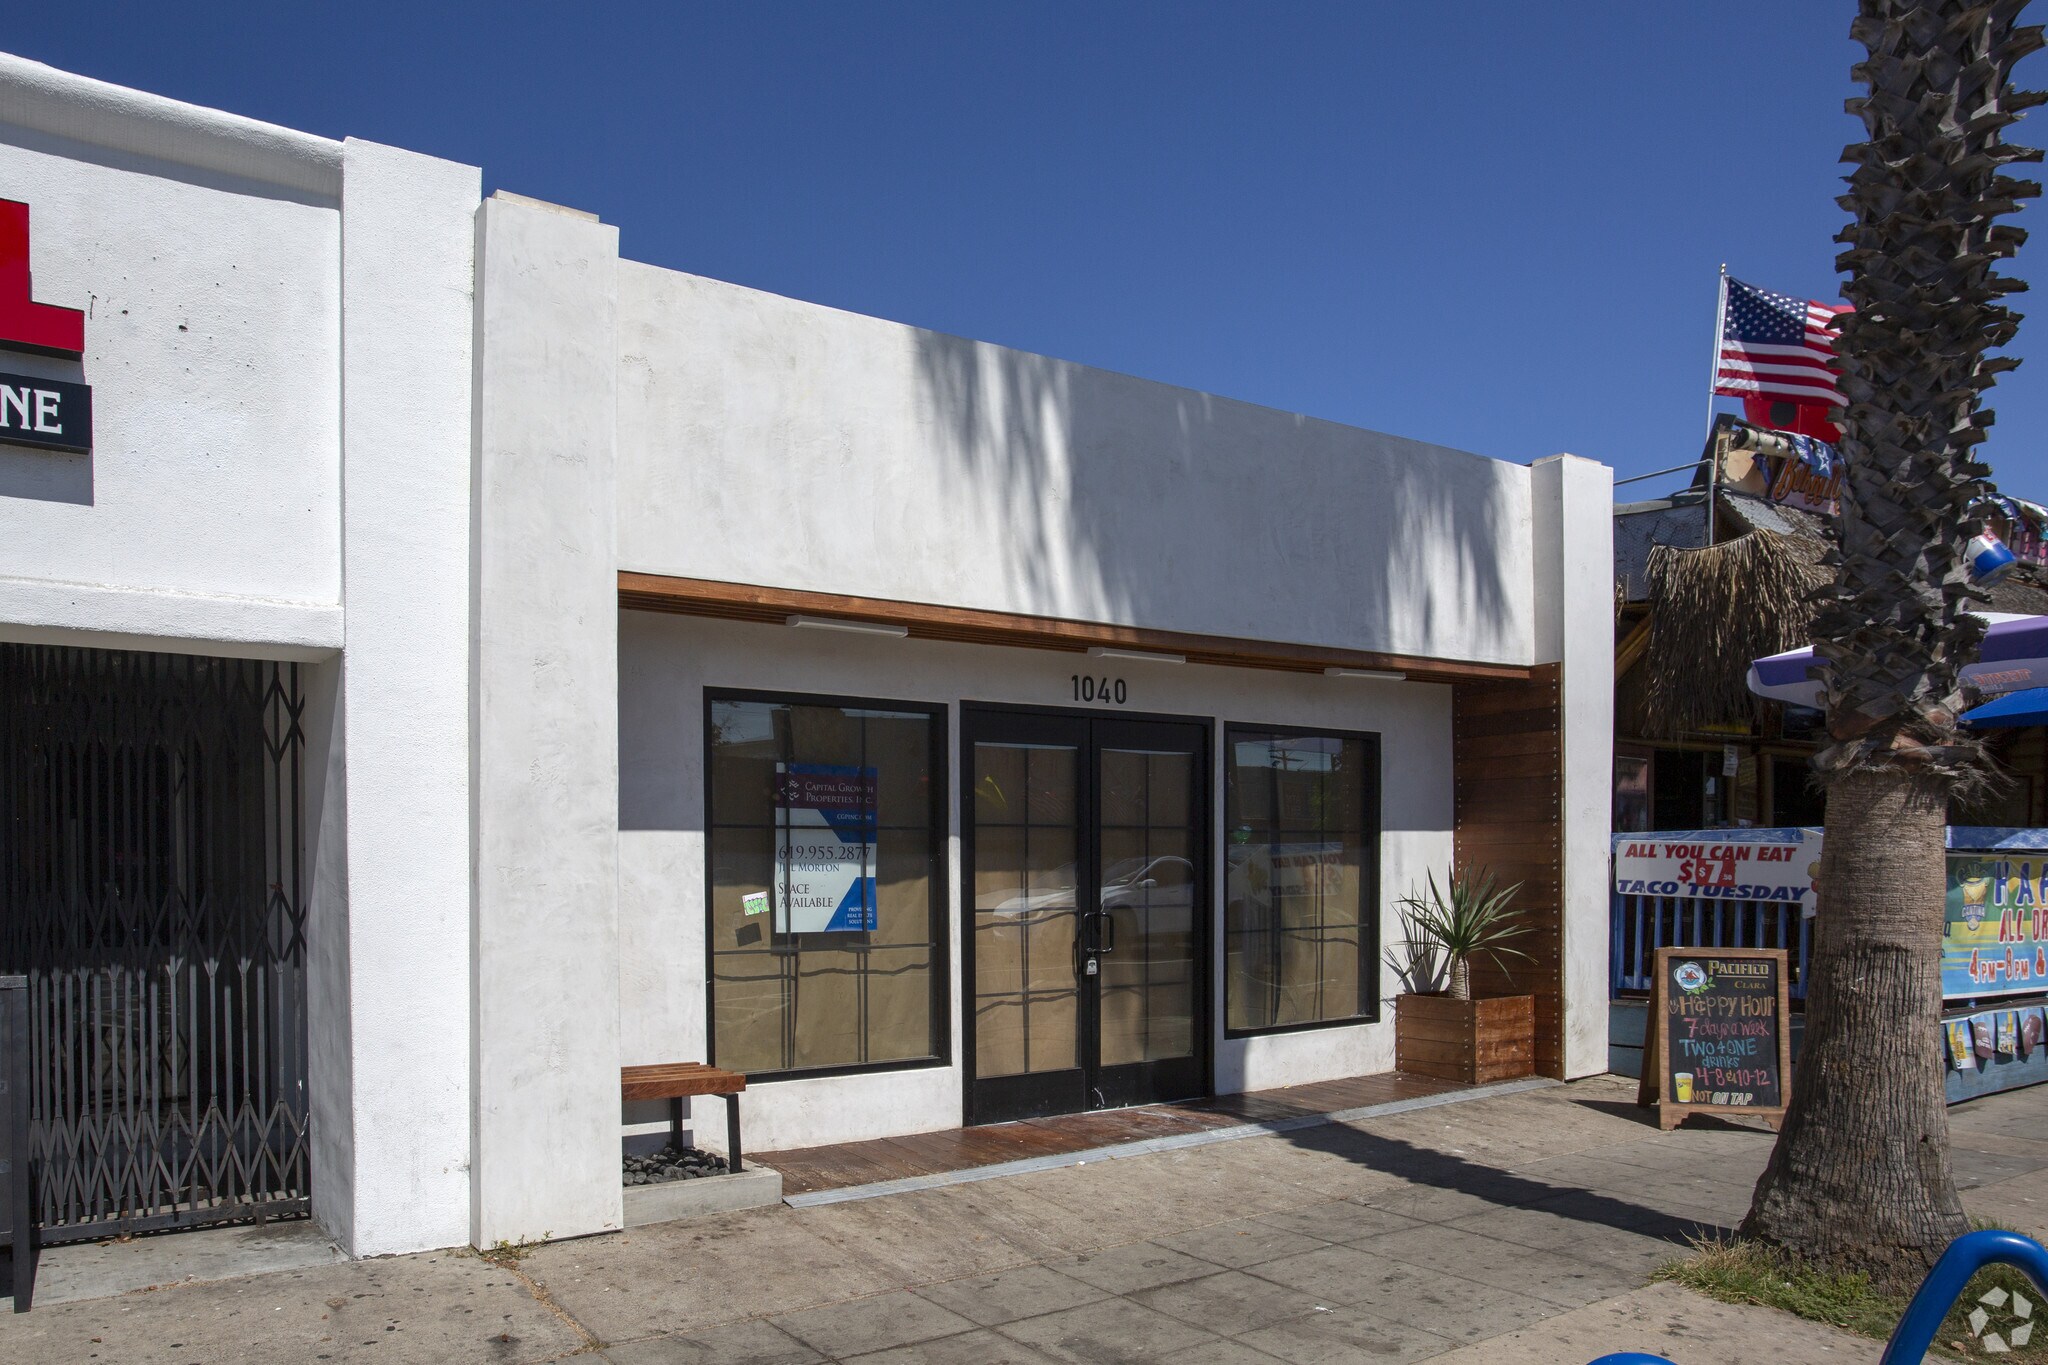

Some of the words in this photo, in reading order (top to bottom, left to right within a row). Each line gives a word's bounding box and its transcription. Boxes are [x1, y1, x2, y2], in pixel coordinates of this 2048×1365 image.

[1071, 674, 1127, 704] 1040
[805, 781, 836, 792] CAPITAL
[838, 783, 874, 793] GROWH
[778, 846, 871, 860] 619.955.2877
[1625, 844, 1658, 858] ALL
[1665, 844, 1704, 860] YOU
[1709, 845, 1751, 861] CAN
[1757, 847, 1797, 862] EAT
[779, 862, 796, 874] JIL
[798, 863, 840, 873] MORTON
[1618, 879, 1679, 895] TACO
[1688, 883, 1811, 901] TUESDAY
[1998, 908, 2024, 944] ALL
[1708, 960, 1769, 976] PACIFICO
[1734, 980, 1767, 990] CLARA
[1684, 1017, 1699, 1038] 7
[1700, 1018, 1729, 1040] days
[1692, 1090, 1713, 1104] NOT
[1711, 1091, 1729, 1105] ON
[1730, 1092, 1753, 1106] TAP
